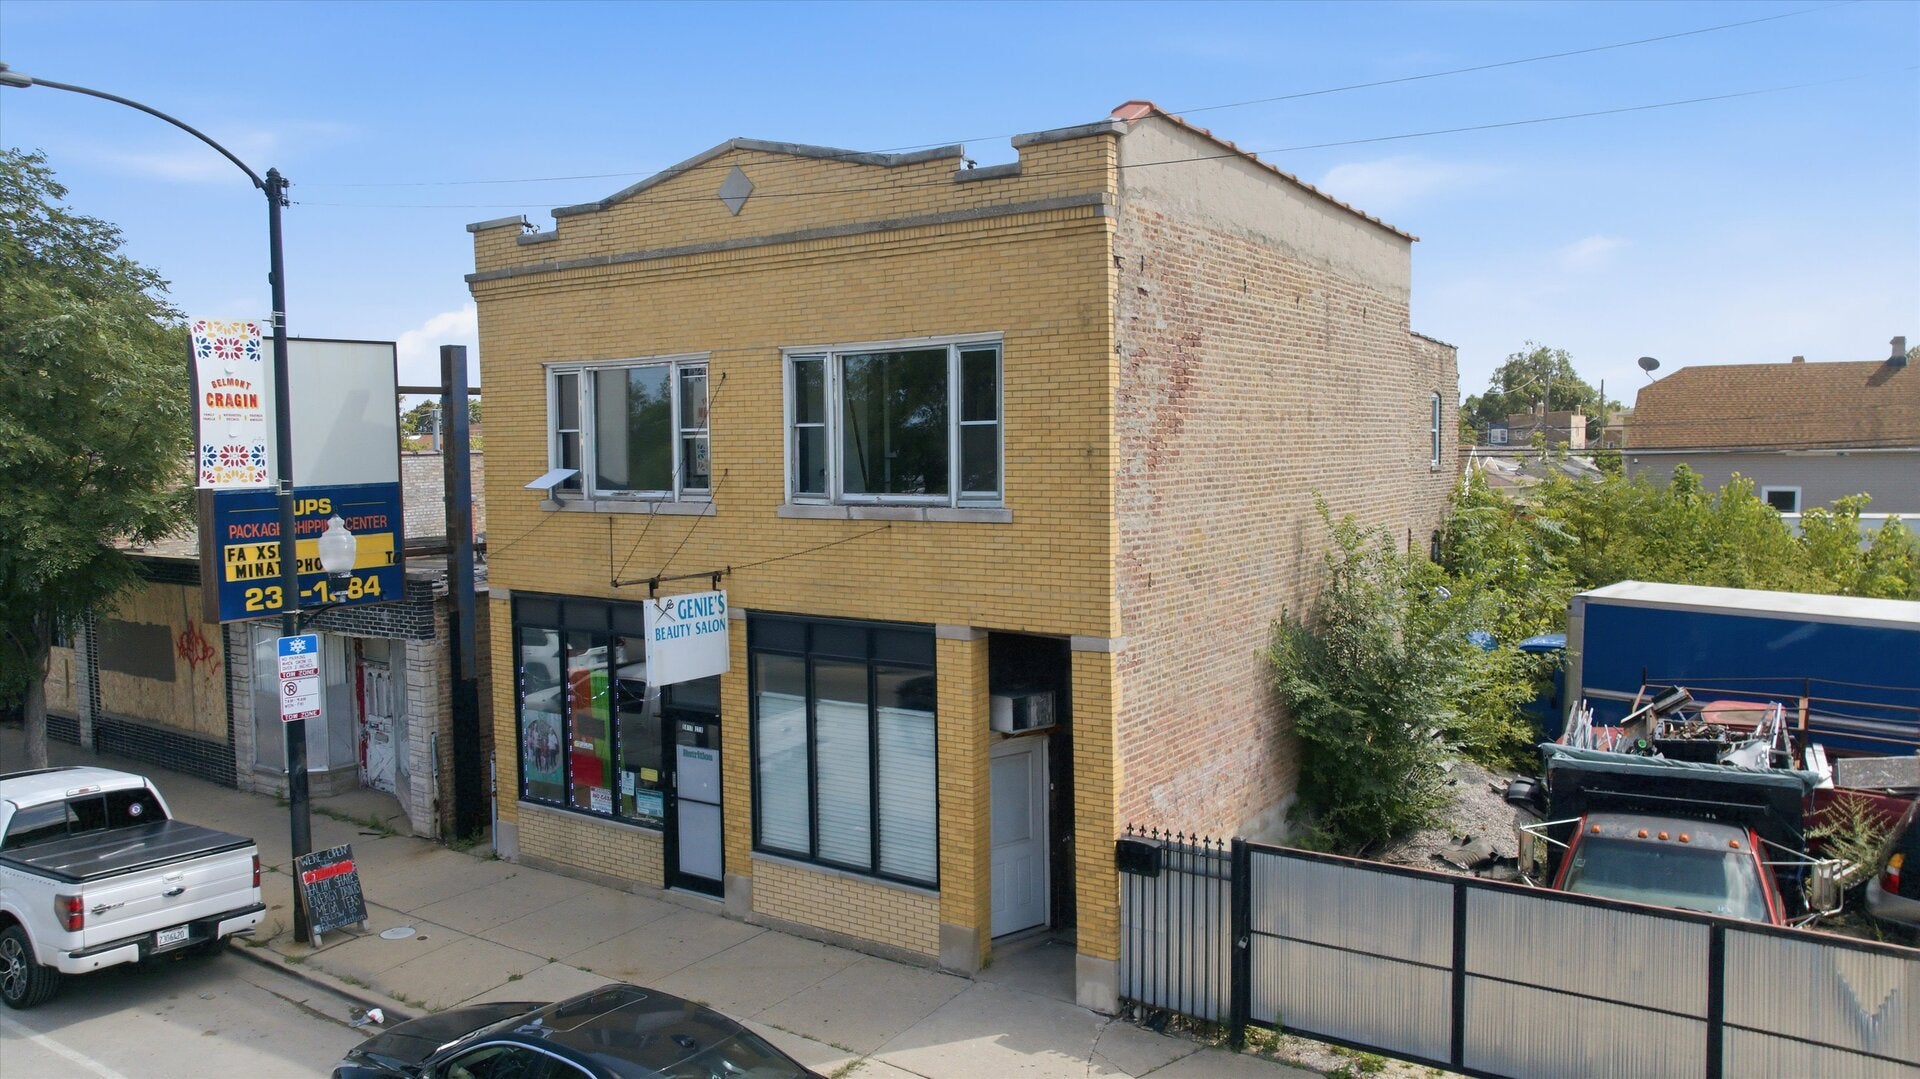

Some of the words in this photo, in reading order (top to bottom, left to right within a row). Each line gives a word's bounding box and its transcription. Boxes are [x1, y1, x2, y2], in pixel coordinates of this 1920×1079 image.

[211, 378, 251, 390] BELMONT
[206, 392, 259, 409] CRAGIN
[293, 498, 332, 516] UPS
[345, 515, 388, 531] CENTER
[677, 594, 726, 620] GENIE'S
[655, 623, 692, 642] BEAUTY
[695, 617, 726, 635] SALON
[299, 668, 314, 677] ZONE
[286, 713, 299, 721] TOW
[301, 710, 317, 718] ZONE
